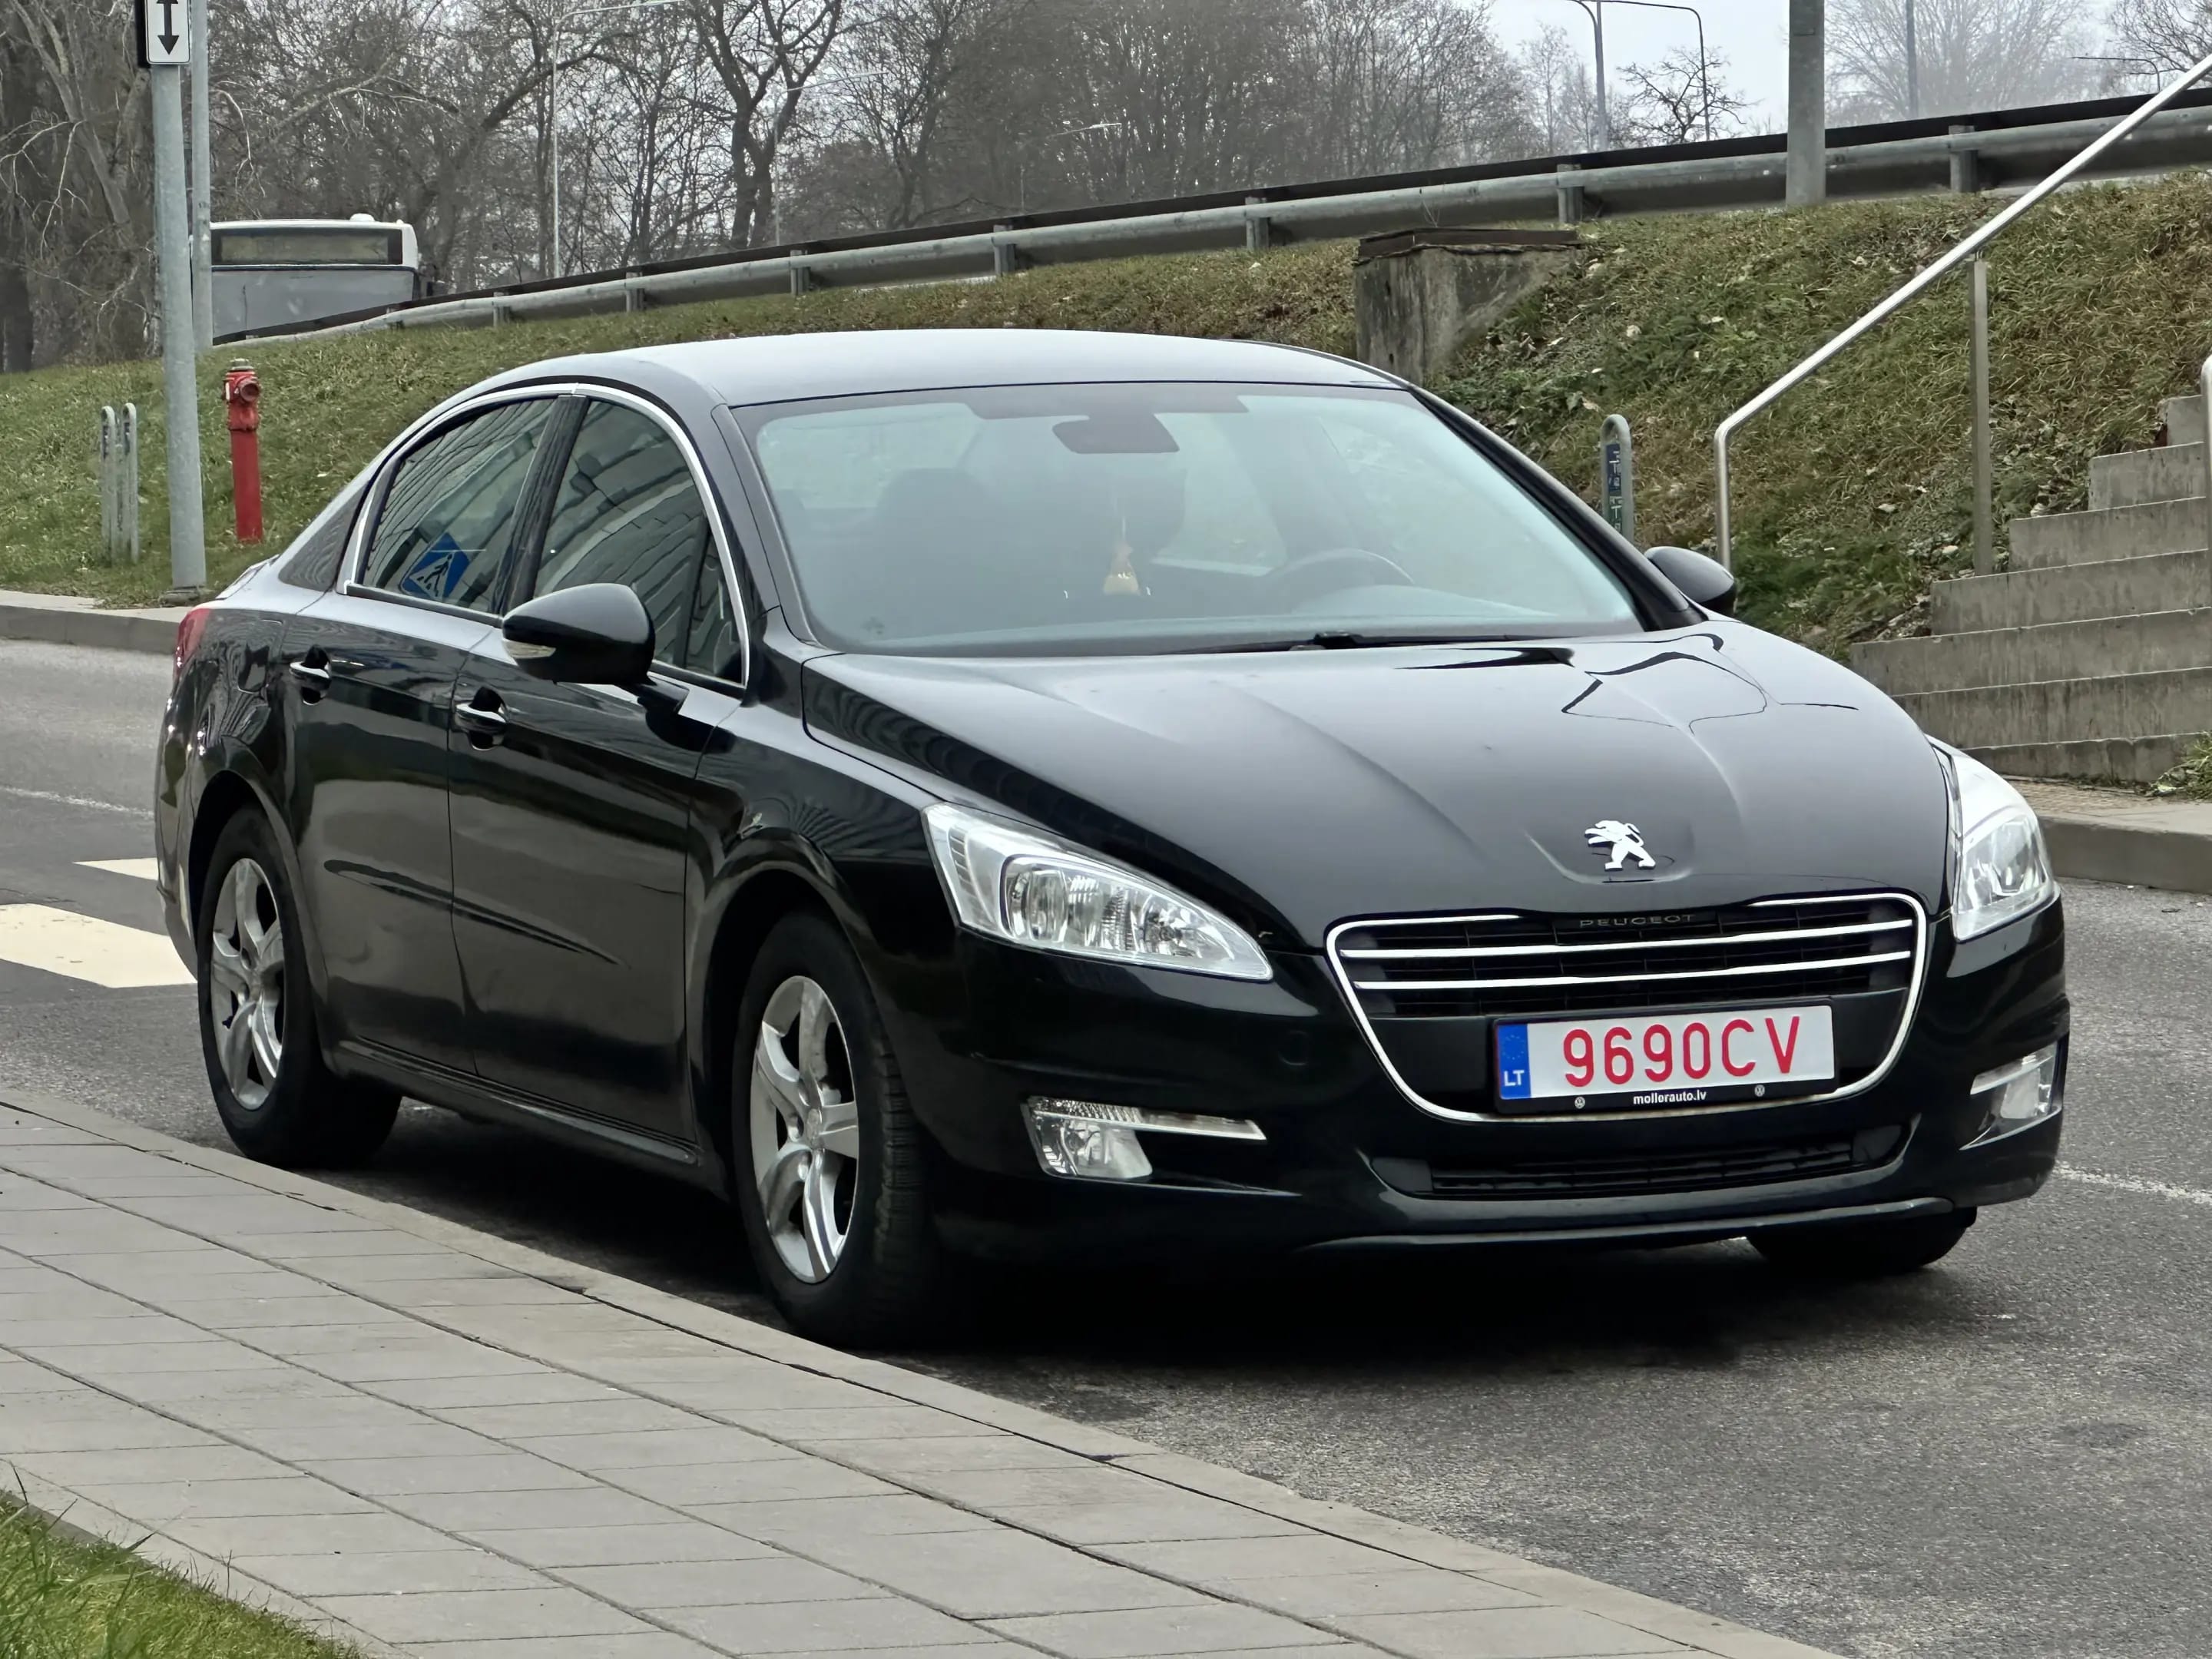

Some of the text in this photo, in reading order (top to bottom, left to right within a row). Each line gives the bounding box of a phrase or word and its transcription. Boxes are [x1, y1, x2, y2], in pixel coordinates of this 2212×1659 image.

[1579, 914, 1695, 928] PEUGEOT
[1562, 1015, 1801, 1088] 9690CV
[1504, 1069, 1525, 1087] LT
